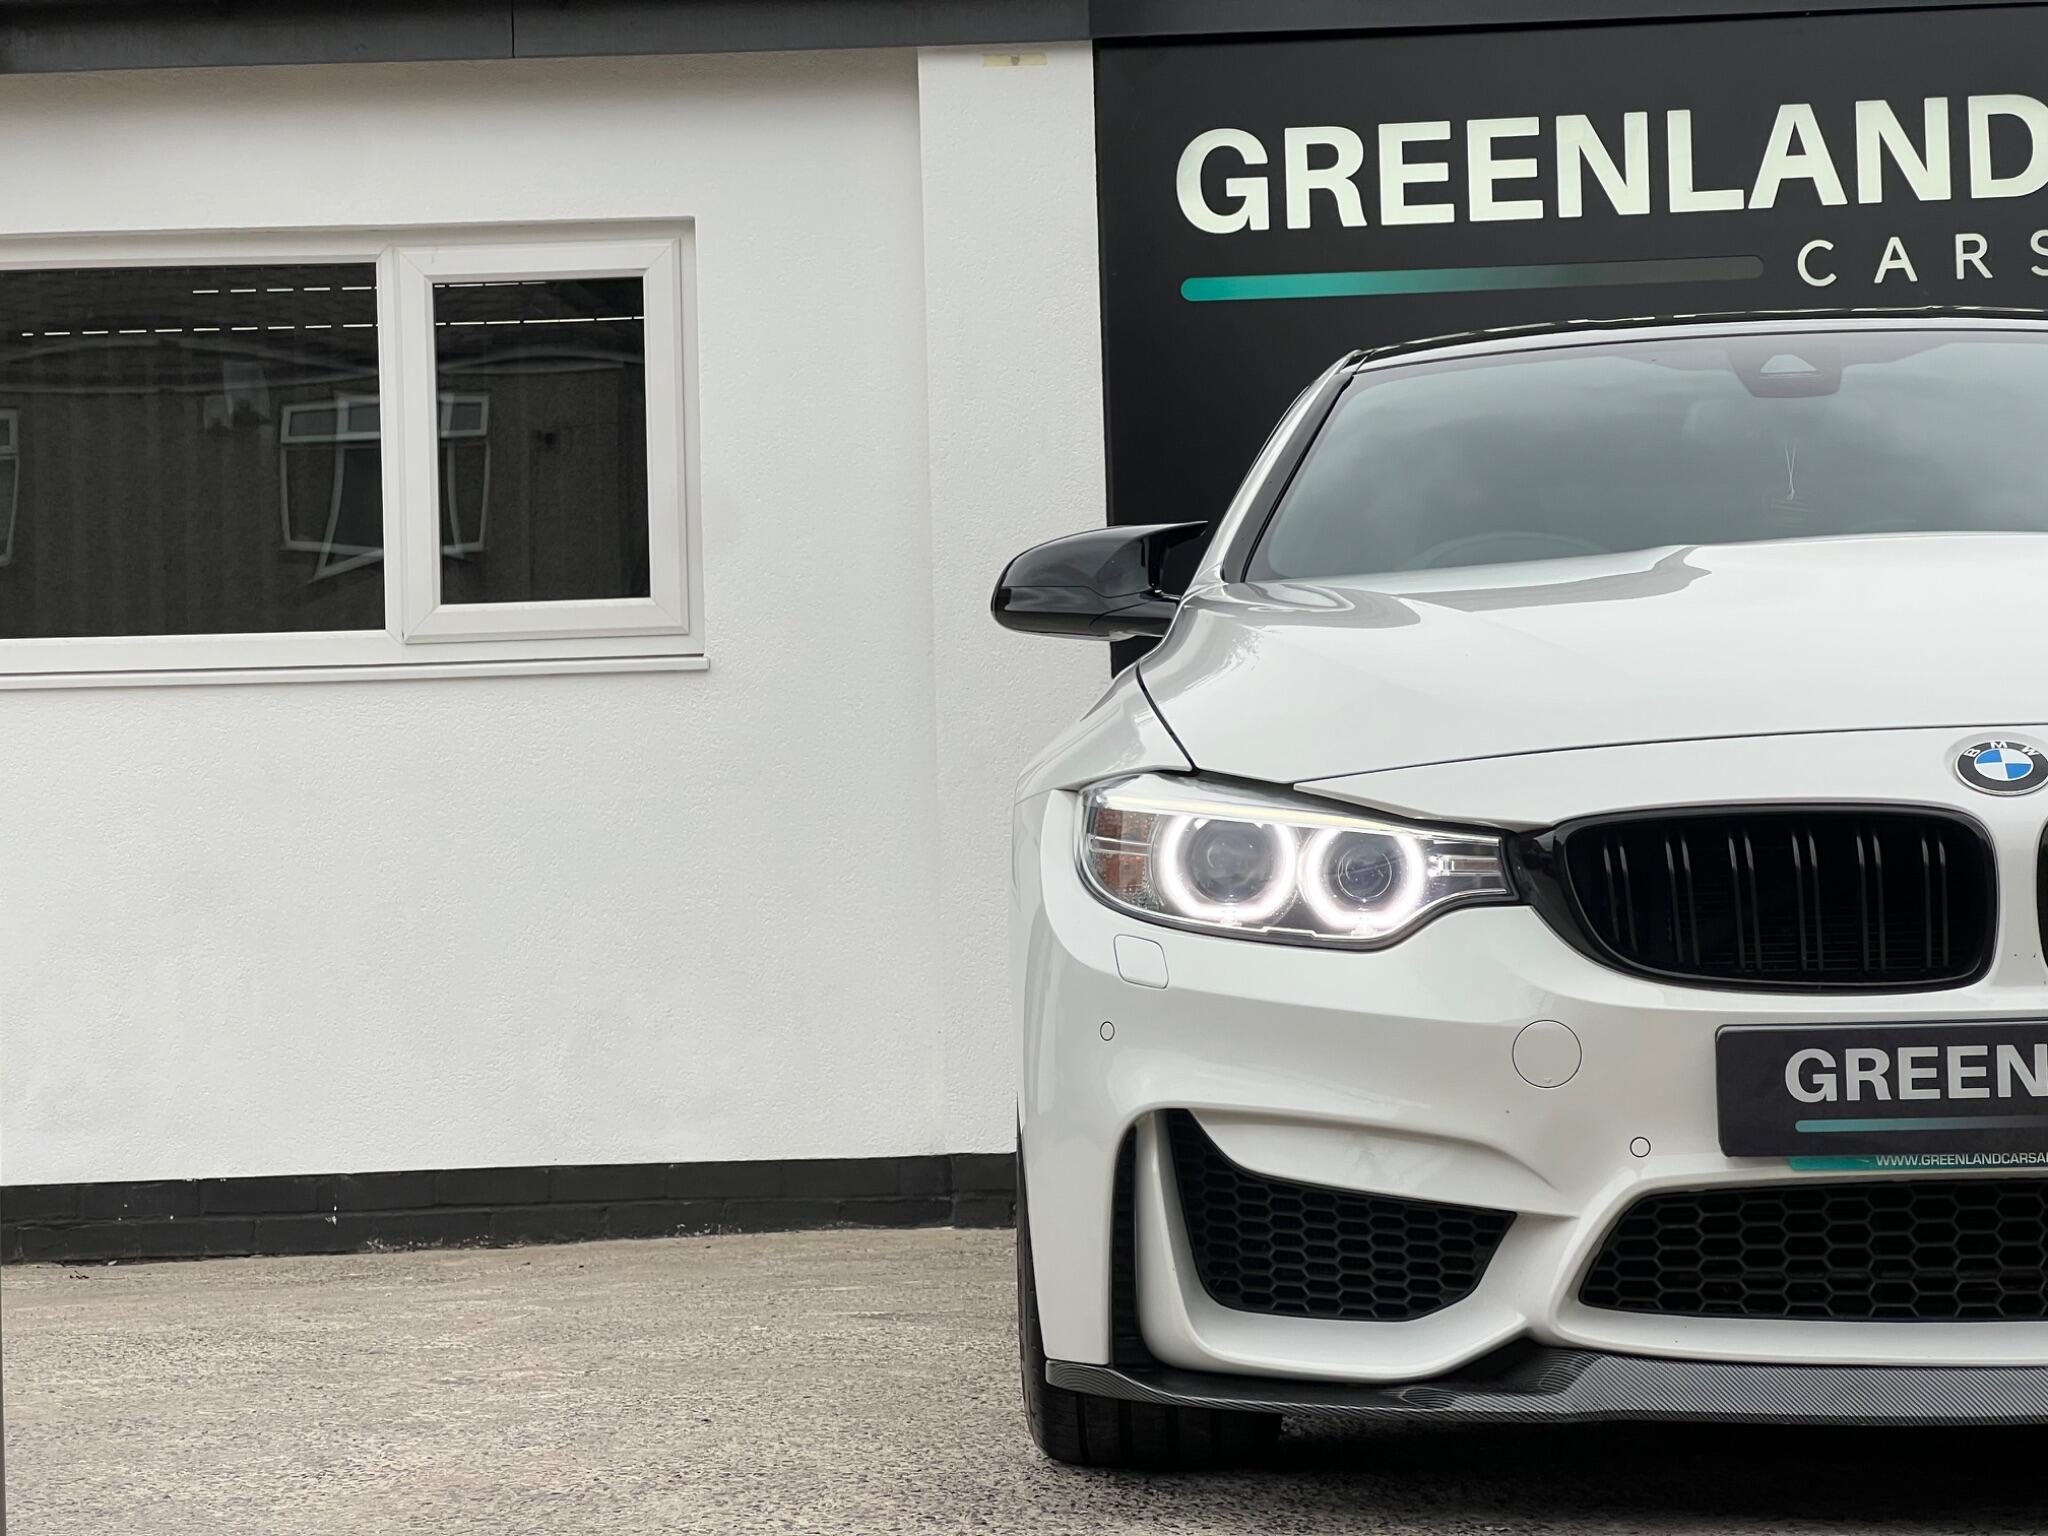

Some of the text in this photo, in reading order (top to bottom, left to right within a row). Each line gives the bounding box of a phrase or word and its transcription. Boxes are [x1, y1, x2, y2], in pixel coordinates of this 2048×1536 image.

[1176, 94, 2048, 234] GREENLAND
[1964, 740, 2040, 758] BMW
[1785, 1043, 2048, 1103] GREEN
[1876, 1152, 2048, 1166] WWW.GREENLANDCARSA
